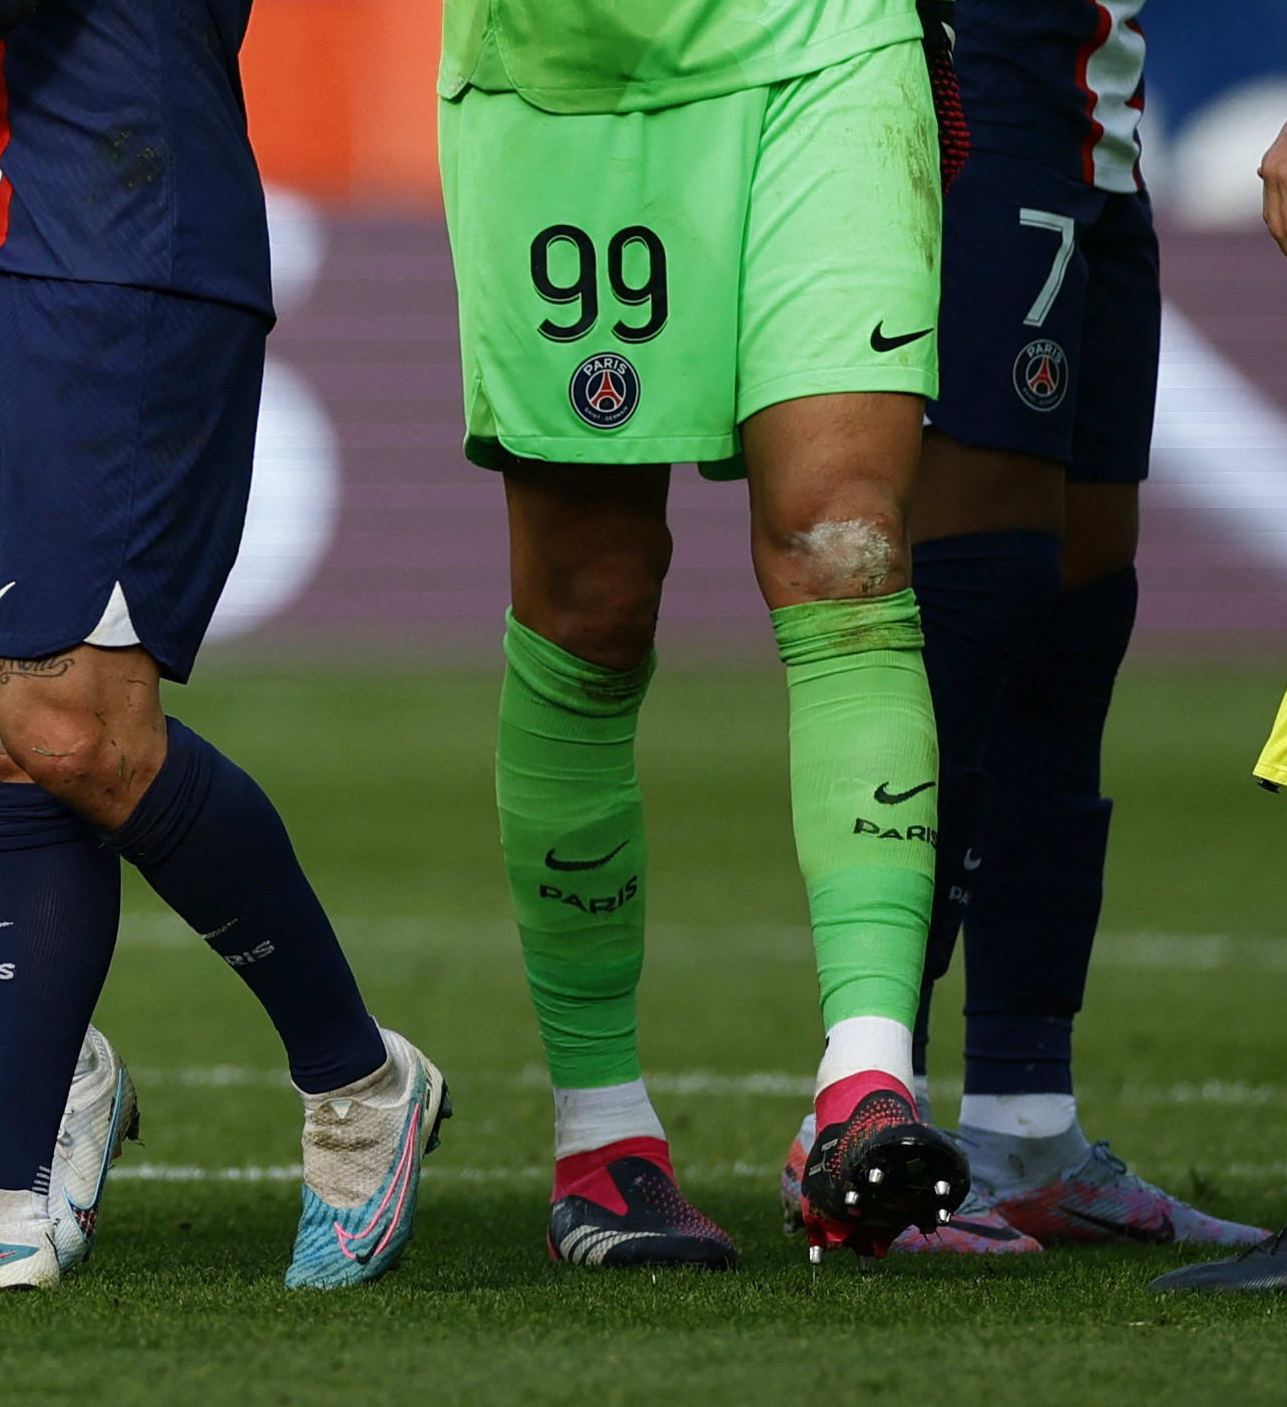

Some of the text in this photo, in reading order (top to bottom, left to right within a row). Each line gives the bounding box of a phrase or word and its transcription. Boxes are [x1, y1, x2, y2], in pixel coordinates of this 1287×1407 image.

[530, 223, 669, 344] 99
[1019, 207, 1075, 327] 7
[583, 357, 628, 376] PARIS
[1026, 344, 1062, 363] PARIS
[853, 817, 937, 849] PARIS
[539, 874, 638, 915] PARIS
